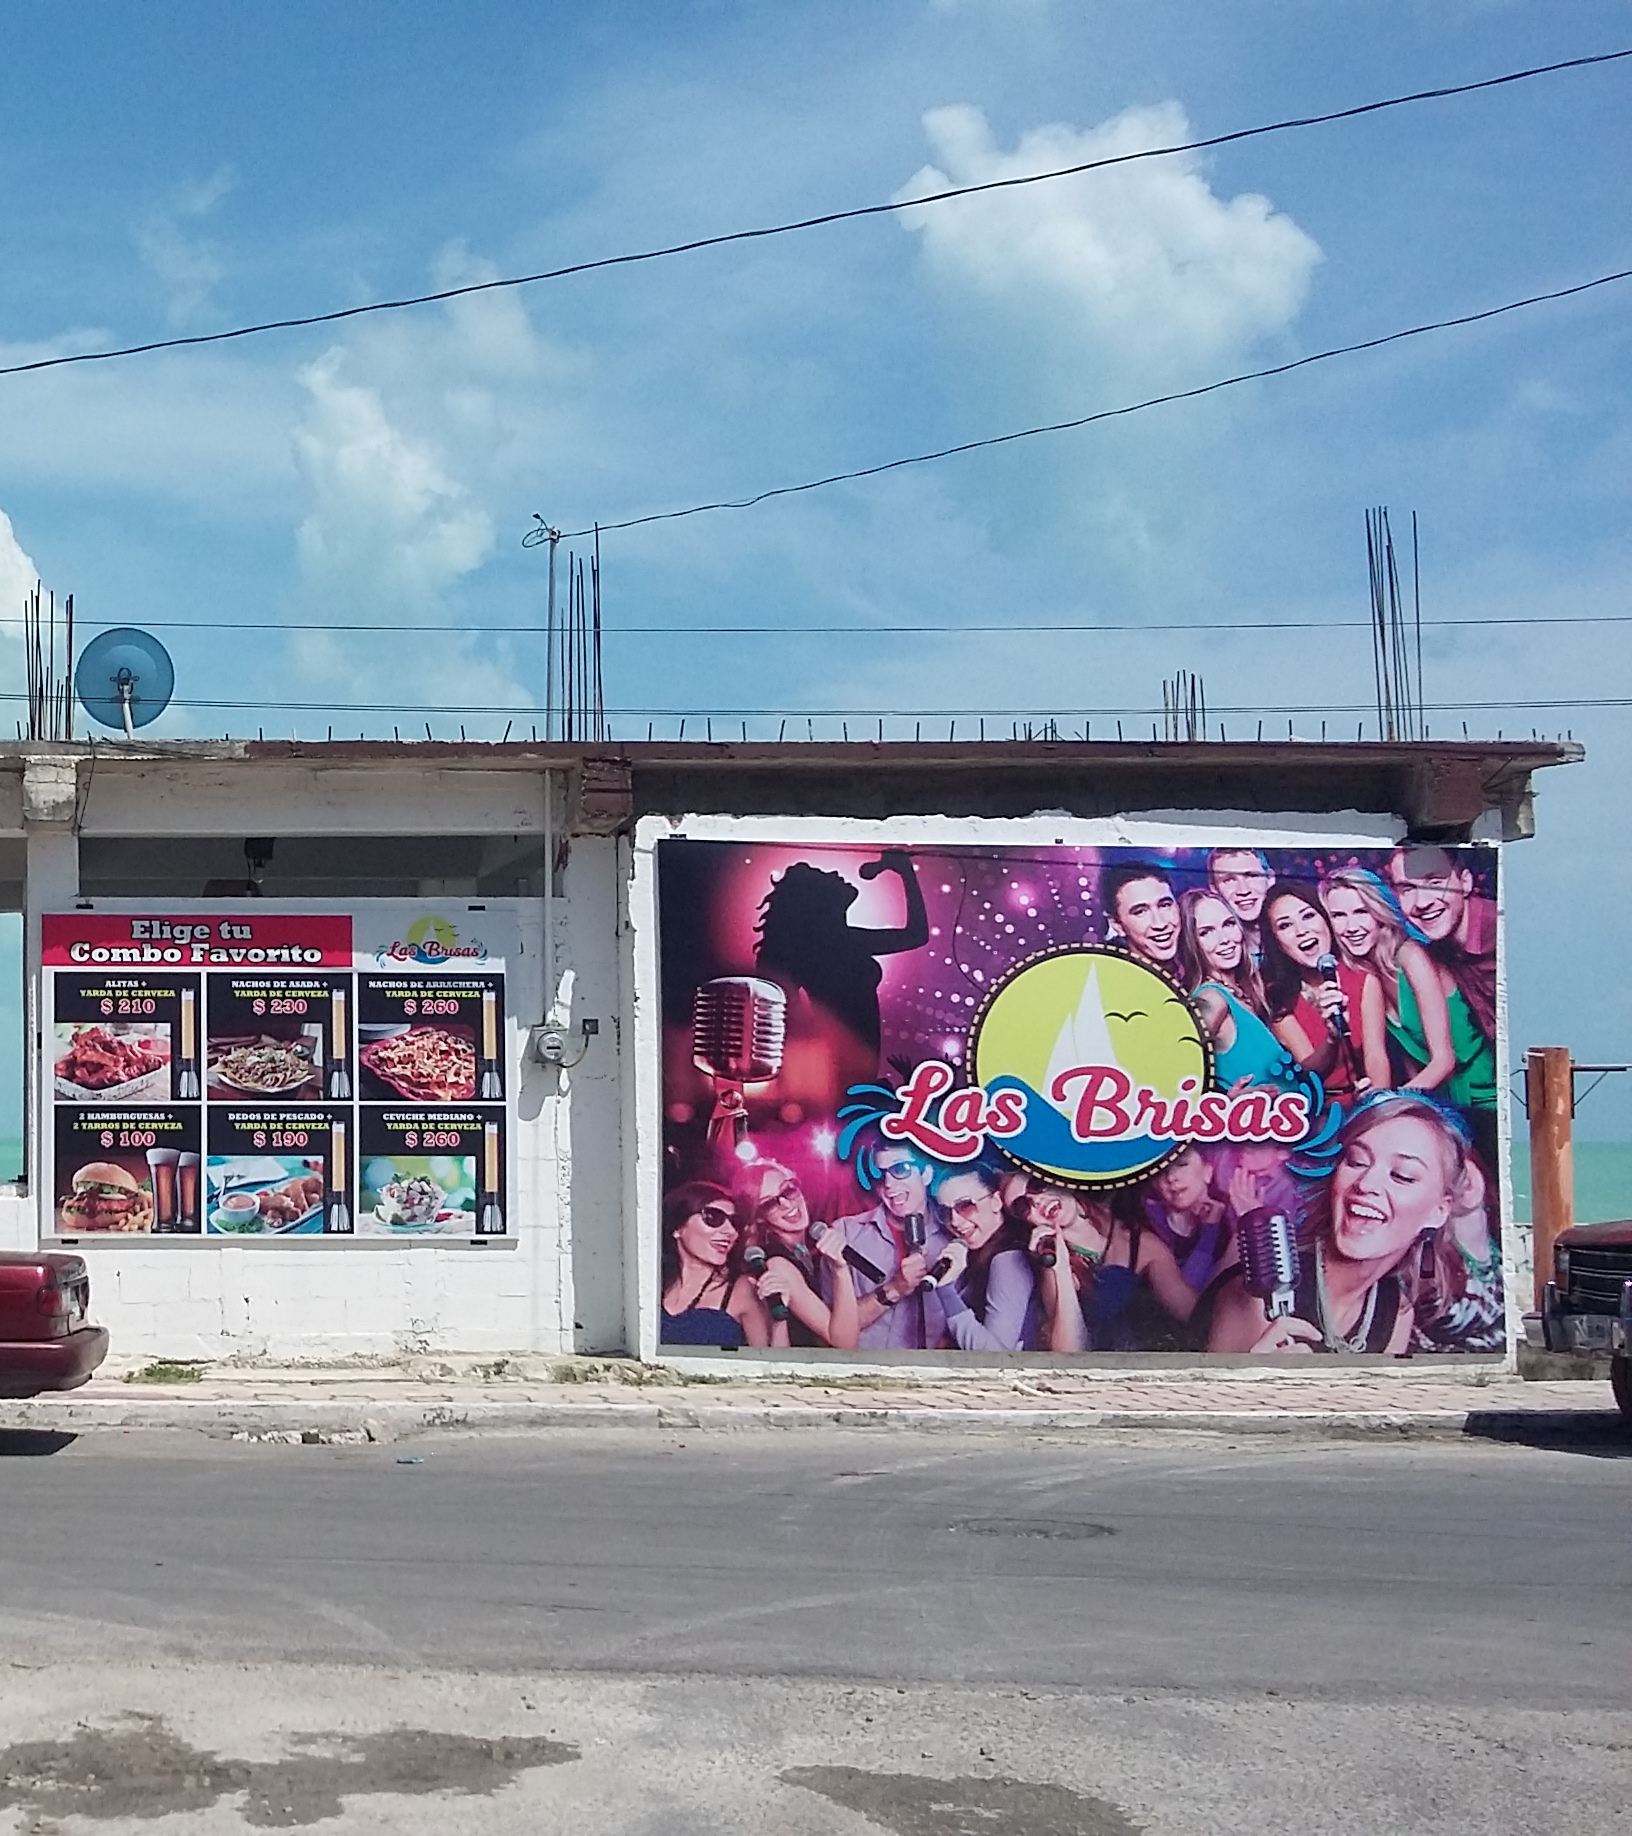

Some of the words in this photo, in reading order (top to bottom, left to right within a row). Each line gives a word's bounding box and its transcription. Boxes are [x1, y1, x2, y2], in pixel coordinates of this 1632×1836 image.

[130, 919, 212, 944] Elige
[219, 920, 252, 940] tu
[70, 942, 183, 964] Combo
[190, 942, 323, 964] Favorito
[386, 941, 416, 962] Las
[423, 941, 479, 957] Brisas
[105, 980, 139, 988] ALITAS
[231, 980, 271, 988] NACHOS
[273, 980, 286, 988] DE
[289, 980, 320, 988] ASADA
[368, 981, 408, 989] NACHOS
[410, 981, 423, 989] DE
[425, 981, 485, 989] ARRACHERA
[80, 989, 113, 997] YARDA
[115, 989, 129, 997] DE
[131, 989, 176, 997] CERVEZA
[234, 990, 267, 998] YARDA
[269, 990, 283, 998] DE
[285, 990, 329, 998] CERVEZA
[385, 990, 418, 998] YARDA
[420, 990, 434, 998] DE
[436, 990, 480, 998] CERVEZA
[101, 998, 113, 1015] $
[118, 999, 155, 1014] 210
[253, 998, 265, 1015] $
[270, 999, 307, 1014] 230
[404, 999, 416, 1016] $
[421, 1000, 459, 1015] 260
[383, 1113, 425, 1121] CEVICHE
[428, 1113, 474, 1121] MEDIANO
[883, 1062, 1025, 1161] Las
[1049, 1064, 1309, 1140] Brisas
[73, 1122, 79, 1130] 2
[81, 1122, 120, 1130] TARROS
[122, 1122, 135, 1130] DE
[138, 1122, 182, 1130] CERVEZA
[234, 1122, 267, 1130] YARDA
[270, 1122, 283, 1130] DE
[285, 1122, 329, 1130] CERVEZA
[101, 1131, 113, 1147] $
[119, 1132, 155, 1146] 100
[253, 1131, 266, 1147] $
[272, 1132, 308, 1146] 190
[405, 1131, 417, 1148] $
[423, 1132, 460, 1147] 260
